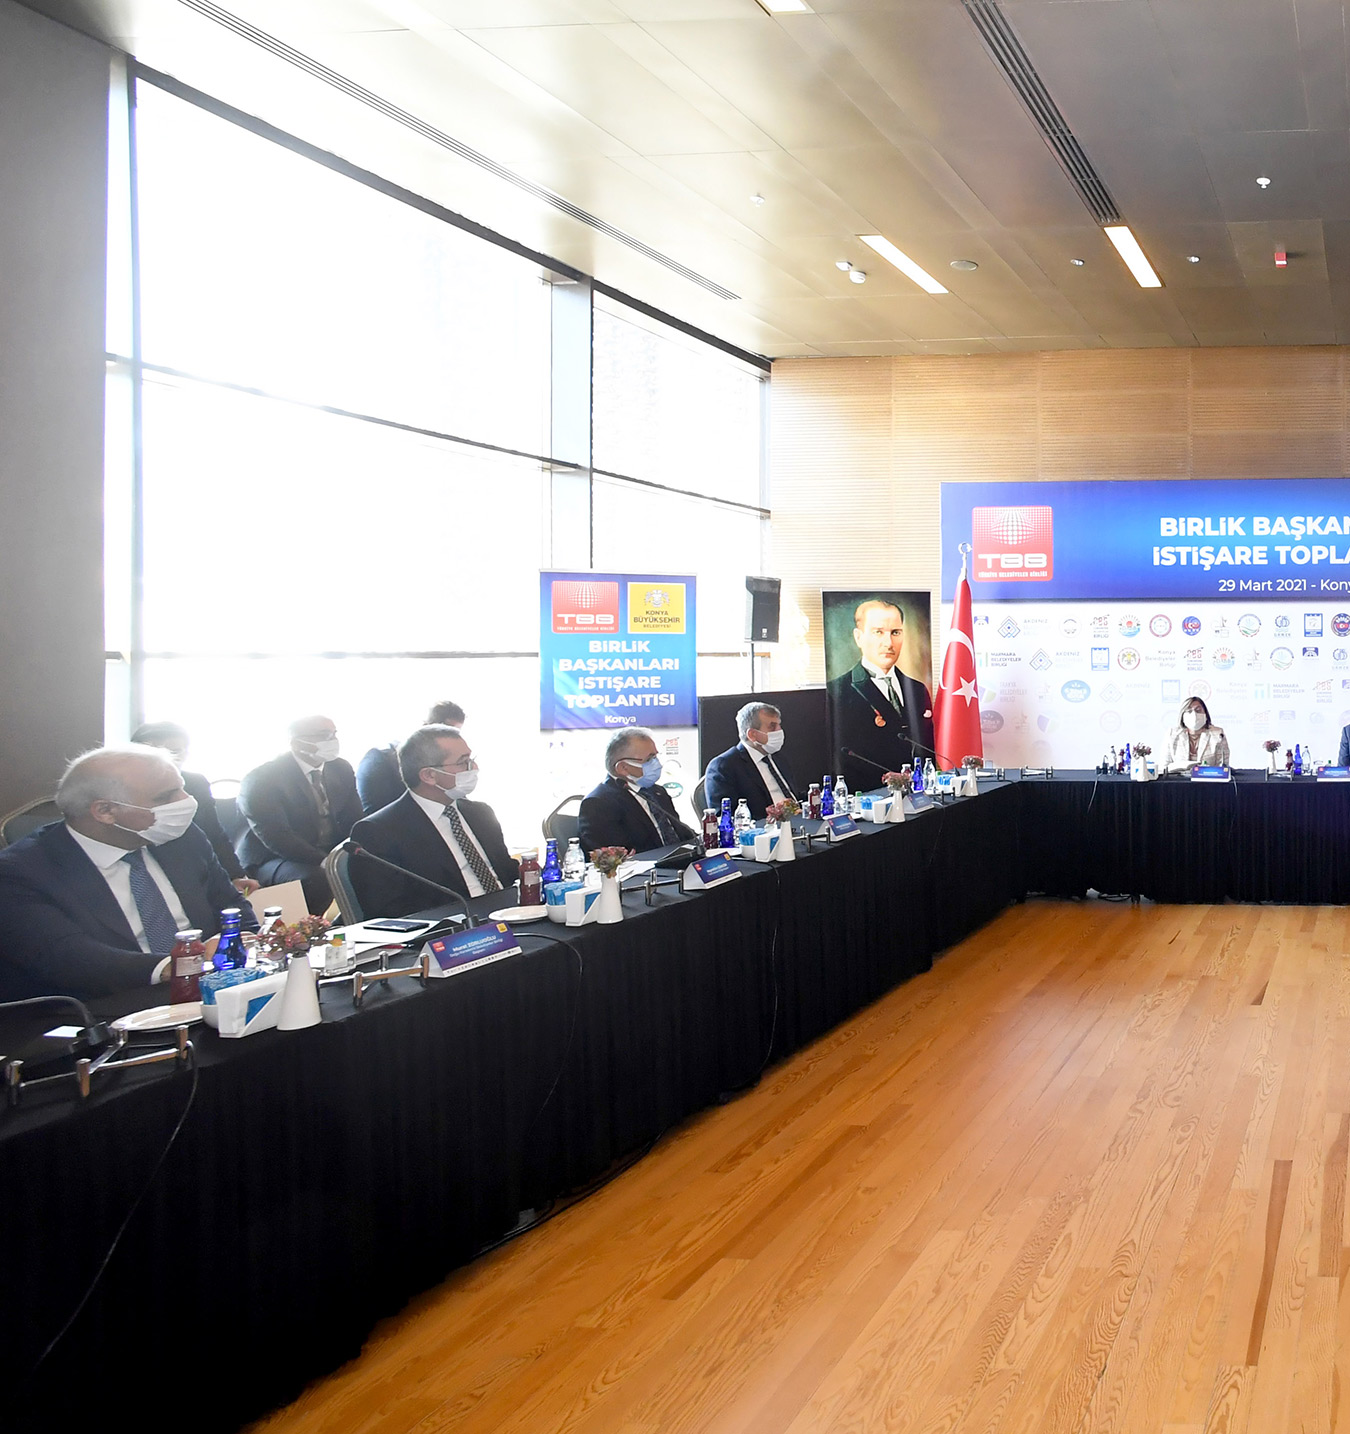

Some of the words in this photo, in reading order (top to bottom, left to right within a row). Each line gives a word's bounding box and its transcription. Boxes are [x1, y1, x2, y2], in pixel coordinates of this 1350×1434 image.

[1160, 517, 1246, 537] BİRLİK
[978, 553, 1047, 568] TBB
[1153, 546, 1268, 571] İSTİŞARE
[1218, 580, 1235, 591] 29
[1240, 580, 1272, 591] Mart
[1276, 580, 1307, 591] 2021
[557, 614, 614, 625] TBB
[589, 640, 650, 653] BİRLİK
[559, 658, 679, 674] BAŞKANLARI
[579, 676, 661, 692] İSTİŞARE
[564, 693, 675, 708] TOPLANTISI
[605, 715, 636, 724] Konya
